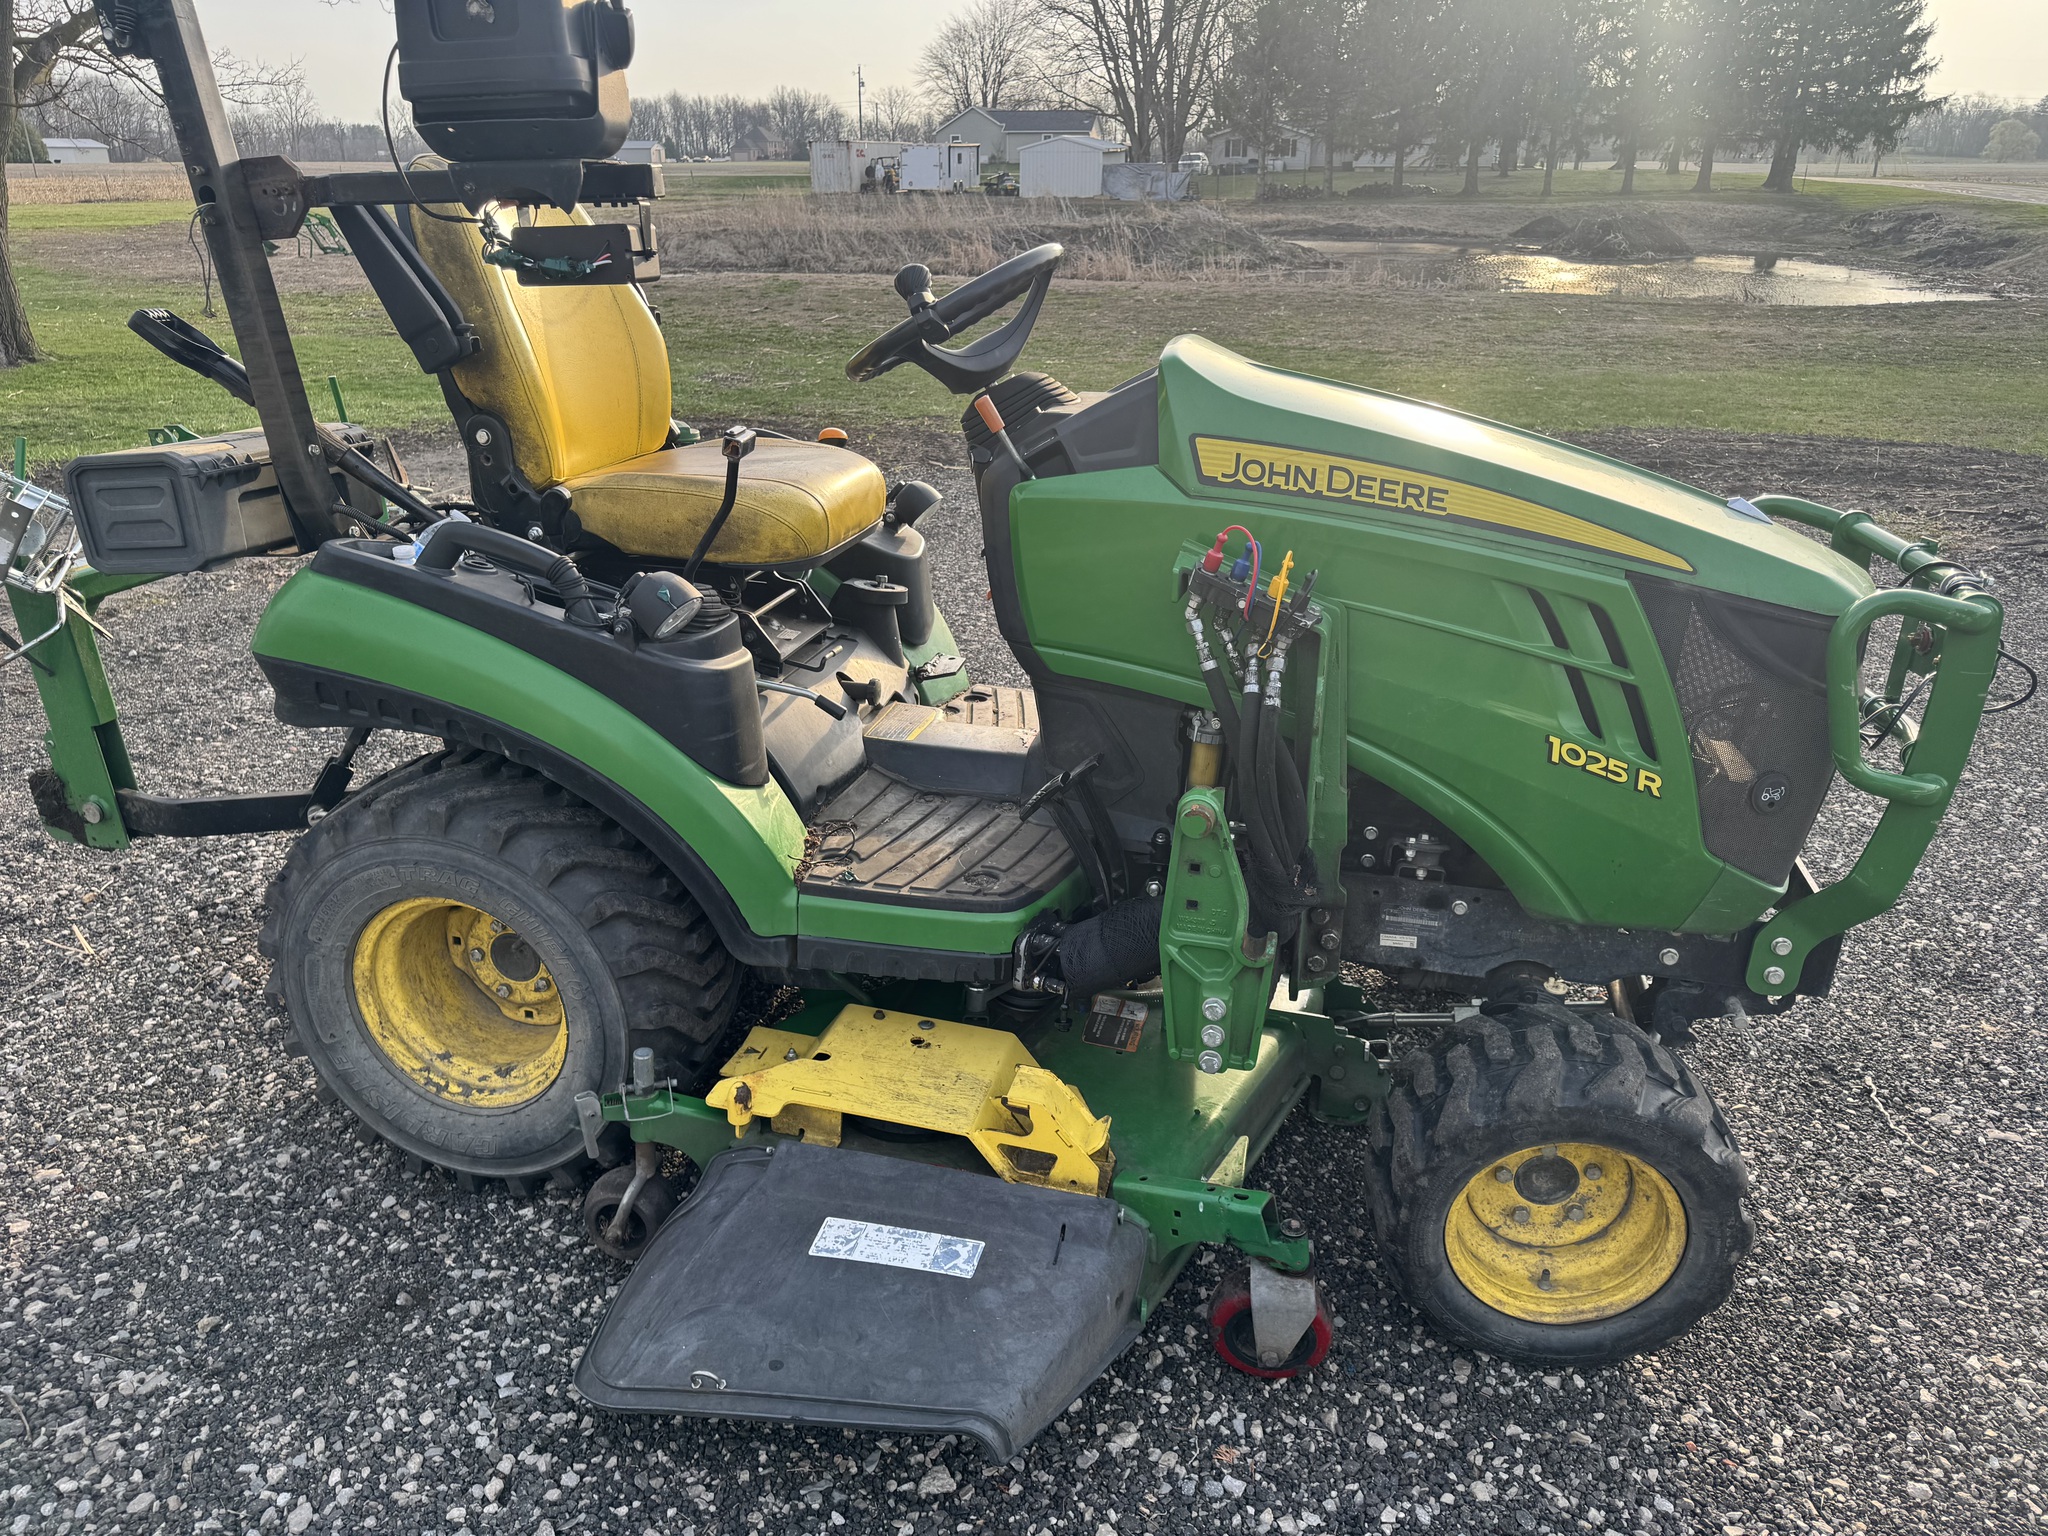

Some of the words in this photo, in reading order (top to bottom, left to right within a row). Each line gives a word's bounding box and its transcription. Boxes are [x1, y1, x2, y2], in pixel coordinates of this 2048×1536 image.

[1219, 452, 1317, 492] JOHN
[1325, 463, 1449, 514] DEERE
[1546, 735, 1629, 783] 1025
[1634, 768, 1663, 798] R
[398, 865, 482, 895] TRAC
[498, 896, 576, 974] CHIEF
[326, 1049, 500, 1157] CARLISLE
